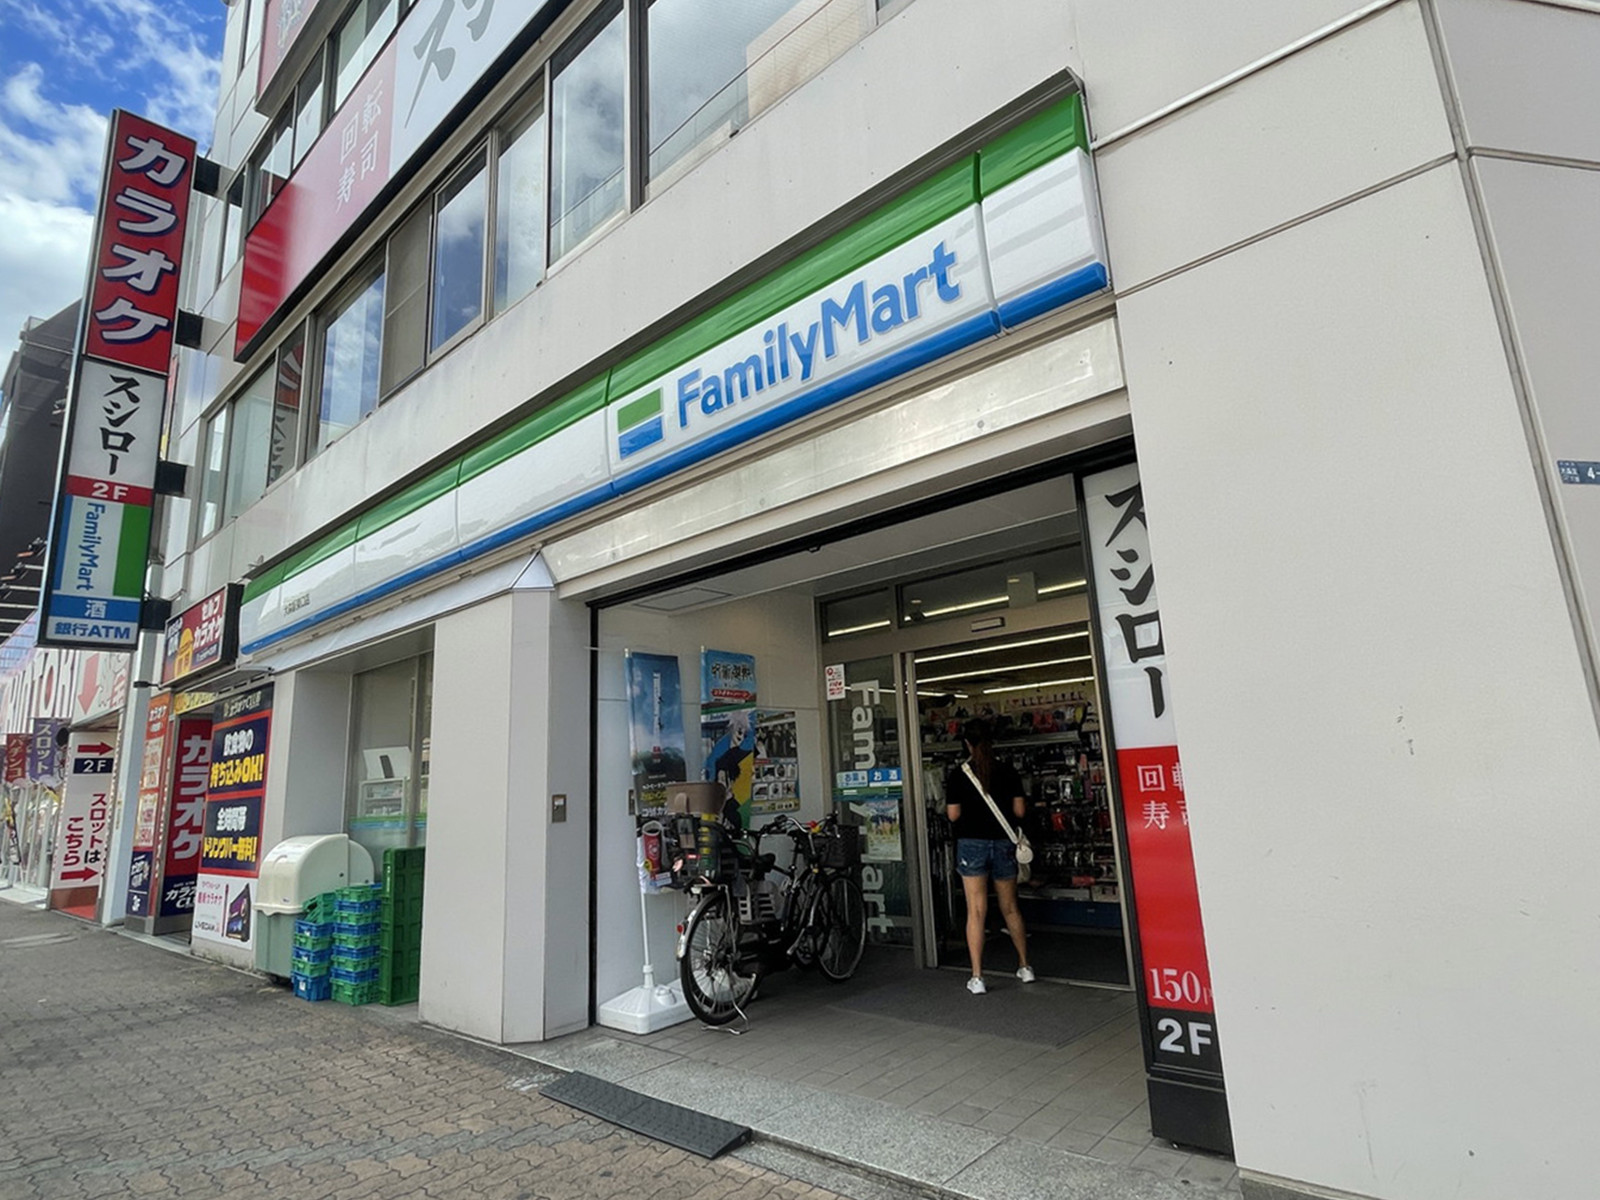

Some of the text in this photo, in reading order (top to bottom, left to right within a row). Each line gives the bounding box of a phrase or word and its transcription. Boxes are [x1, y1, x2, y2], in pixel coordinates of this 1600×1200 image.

[94, 135, 187, 343] カラオケ
[677, 240, 962, 428] FamilyMart
[100, 374, 141, 476] スシロー
[91, 482, 129, 500] 2F
[76, 502, 106, 592] FamilyMart
[84, 600, 108, 619] 酒
[1104, 481, 1165, 718] スシロー
[54, 621, 131, 640] 銀行ATM
[193, 615, 222, 650] カラオケ
[36, 723, 52, 774] スロット
[82, 759, 107, 773] 2F
[173, 735, 211, 859] カラオケ
[63, 816, 84, 867] こちら
[84, 793, 107, 864] スロットは
[1157, 1017, 1212, 1056] 2F
